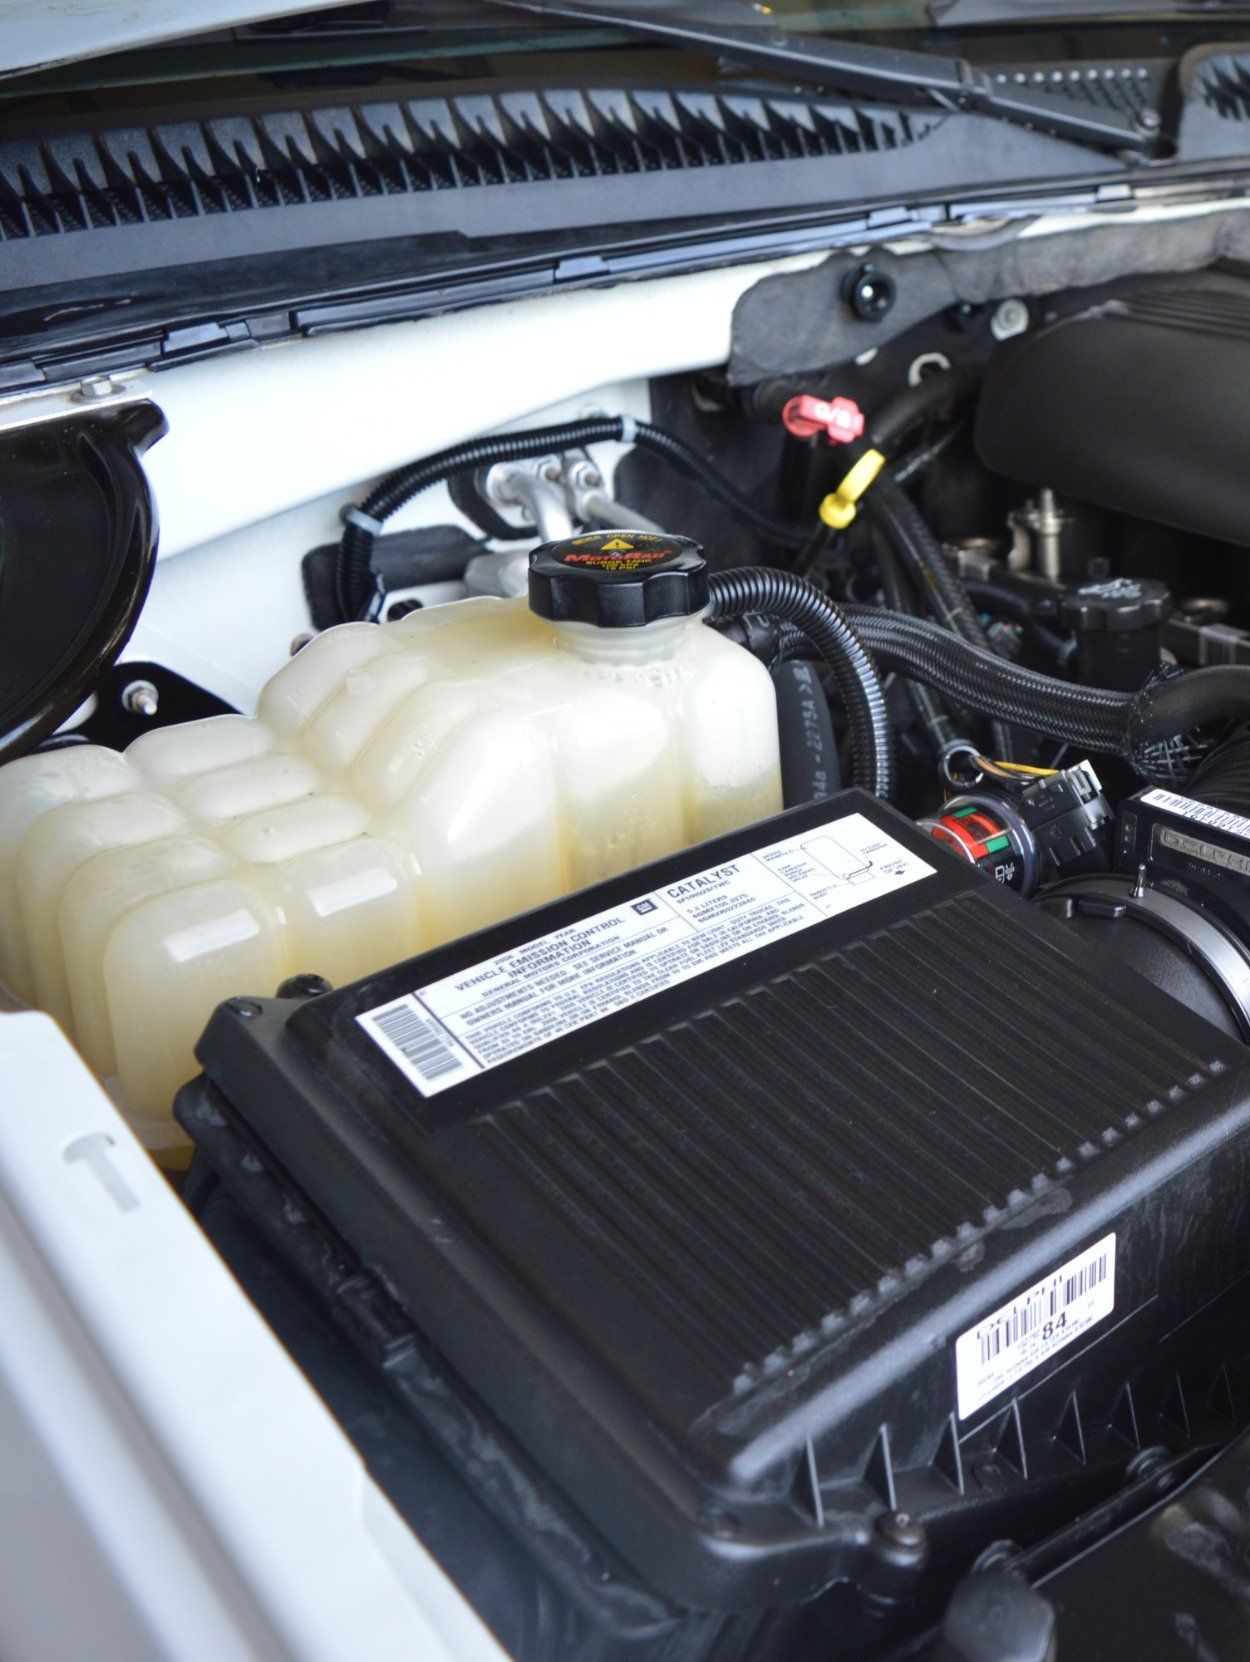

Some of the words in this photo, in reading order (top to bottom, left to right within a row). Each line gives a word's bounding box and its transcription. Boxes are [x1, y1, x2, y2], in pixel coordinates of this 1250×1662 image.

[667, 864, 741, 897] CATALYST
[699, 894, 727, 907] LITERS
[454, 966, 507, 991] VEHICLE
[507, 939, 569, 967] EMISSION
[568, 916, 625, 942] CONTROL
[506, 939, 591, 977] INFORMATION
[518, 940, 547, 954] MODEL
[459, 1010, 473, 1018] NO
[472, 984, 535, 1013] ADJUSTMENTS
[571, 960, 589, 970] SEE
[588, 945, 623, 962] SERVICE
[621, 931, 656, 948] MANUAL
[655, 926, 669, 934] OR
[481, 978, 521, 996] GENERAL
[522, 960, 560, 978] MOTORS
[560, 935, 621, 962] CORPORATION
[503, 991, 538, 1009] MANUAL
[538, 983, 557, 993] FOR
[556, 973, 580, 985] MORE
[483, 1017, 511, 1031] VEHICLE
[1042, 1312, 1068, 1341] 84
